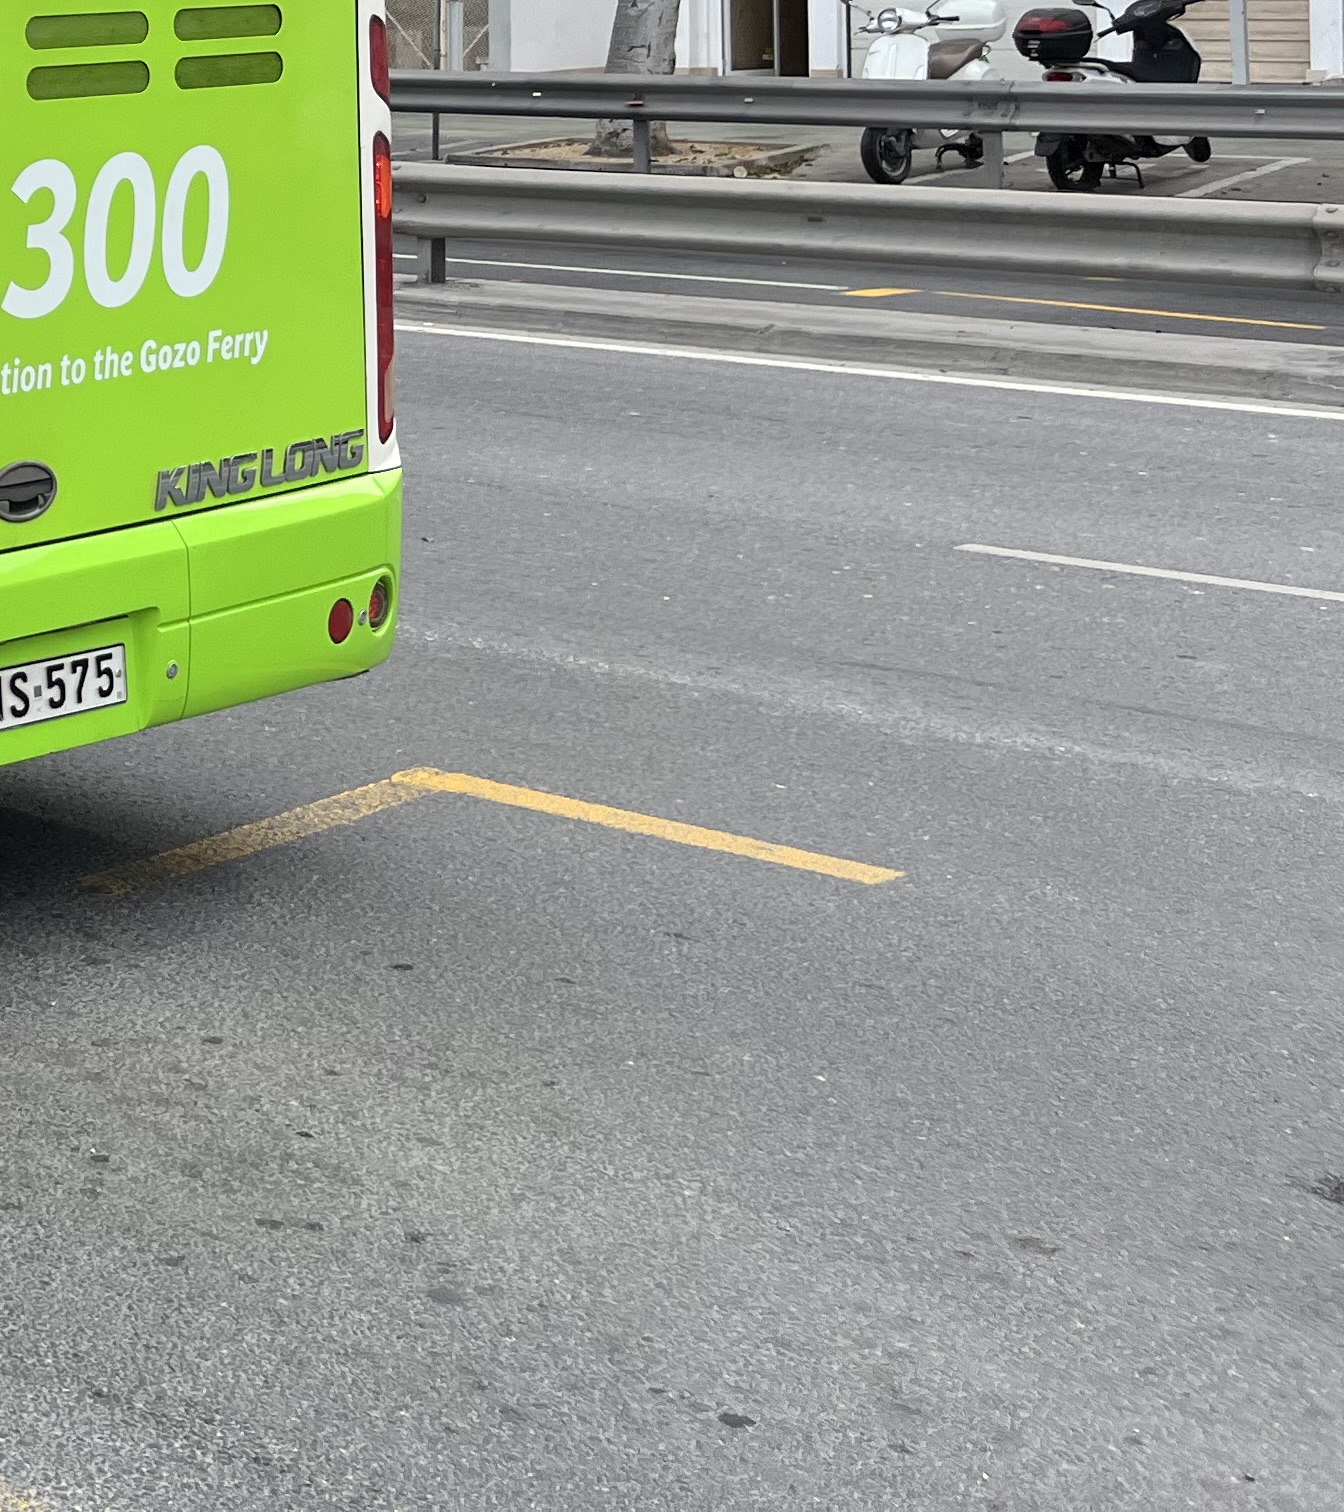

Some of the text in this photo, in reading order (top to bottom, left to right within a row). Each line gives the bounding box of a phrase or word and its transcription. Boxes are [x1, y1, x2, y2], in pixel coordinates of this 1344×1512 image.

[59, 354, 86, 386] to
[93, 345, 134, 381] the
[139, 338, 201, 374] Gozo
[206, 328, 269, 366] Ferry
